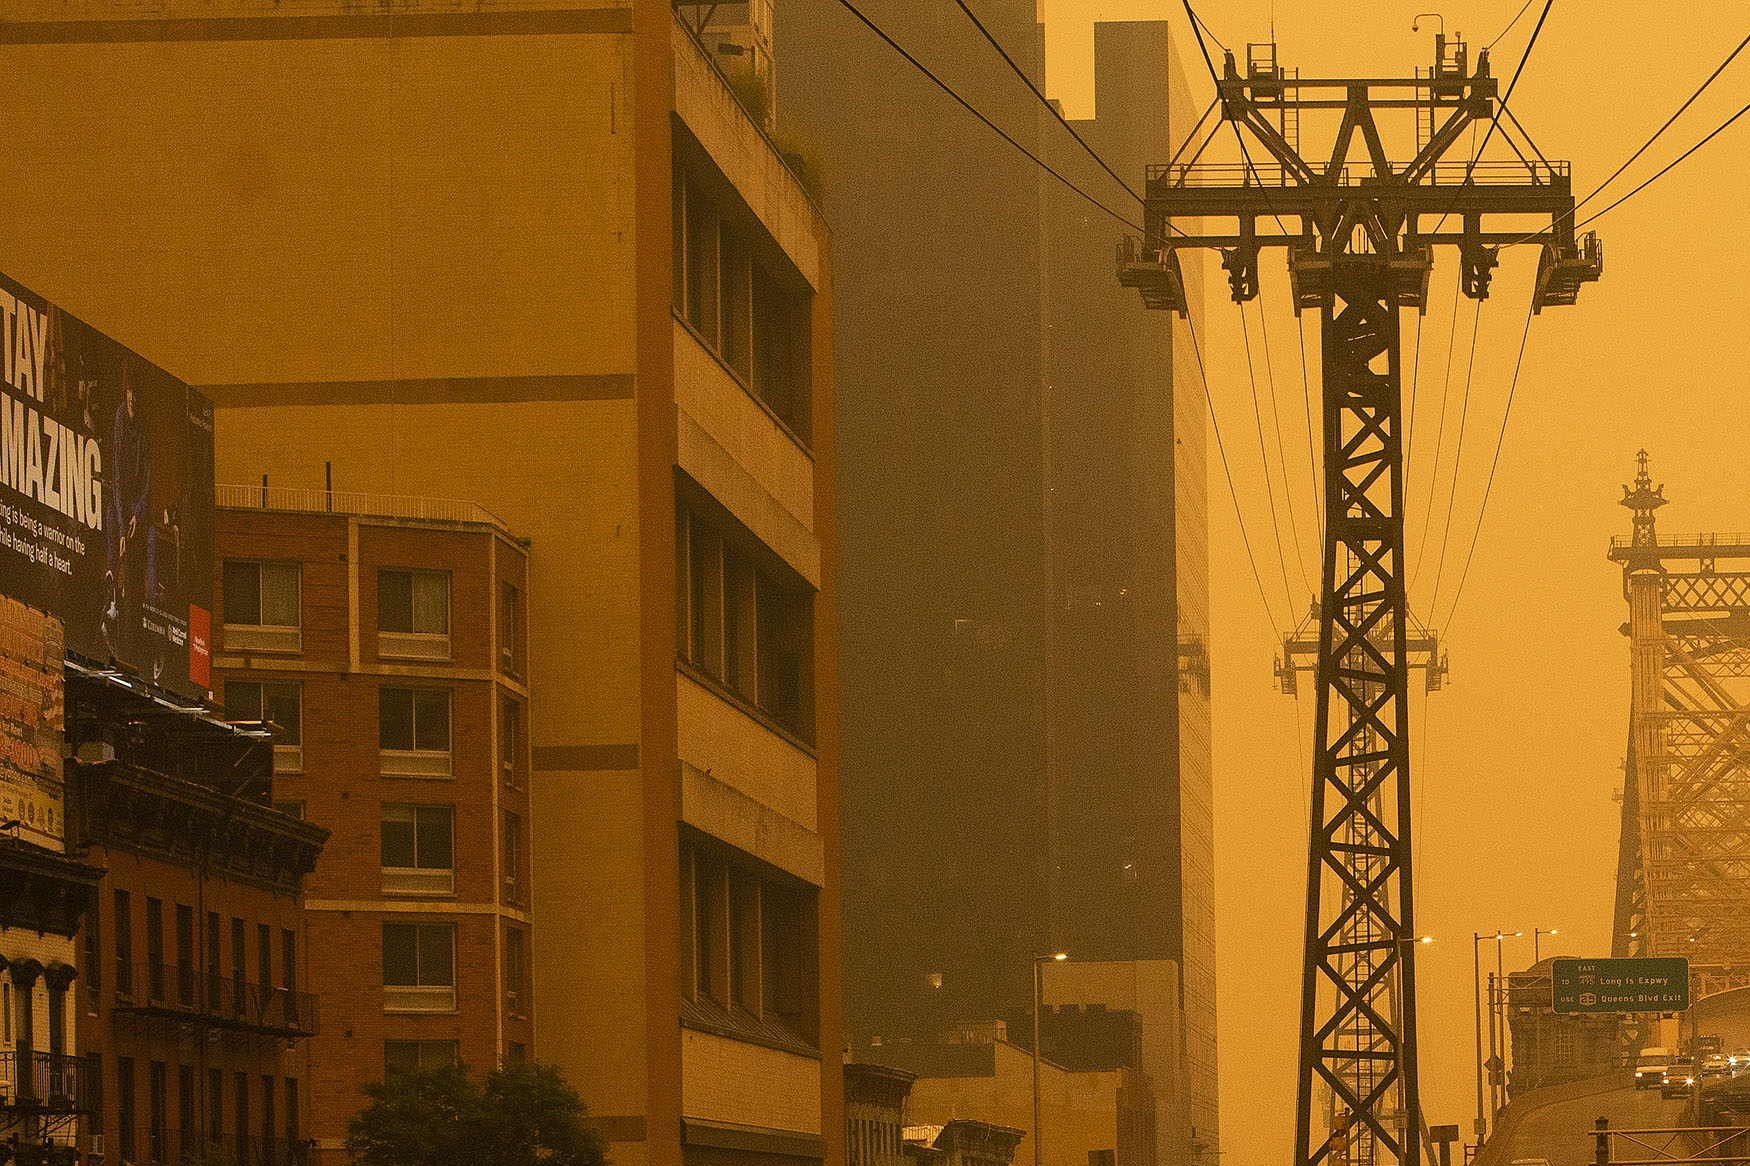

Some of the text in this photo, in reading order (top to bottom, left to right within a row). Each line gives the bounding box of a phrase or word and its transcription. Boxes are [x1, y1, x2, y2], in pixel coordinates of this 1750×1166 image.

[0, 391, 102, 531] MAZING
[12, 505, 18, 524] is
[20, 508, 38, 538] being
[38, 522, 43, 536] a
[44, 524, 65, 546] warrior
[66, 535, 74, 552] on
[75, 536, 86, 556] the
[13, 532, 35, 563] having
[36, 542, 48, 565] half
[48, 554, 53, 567] a
[54, 551, 72, 576] heart.
[1581, 995, 1594, 1004] 25
[1600, 977, 1622, 987] Long
[1638, 977, 1668, 986] Expwy
